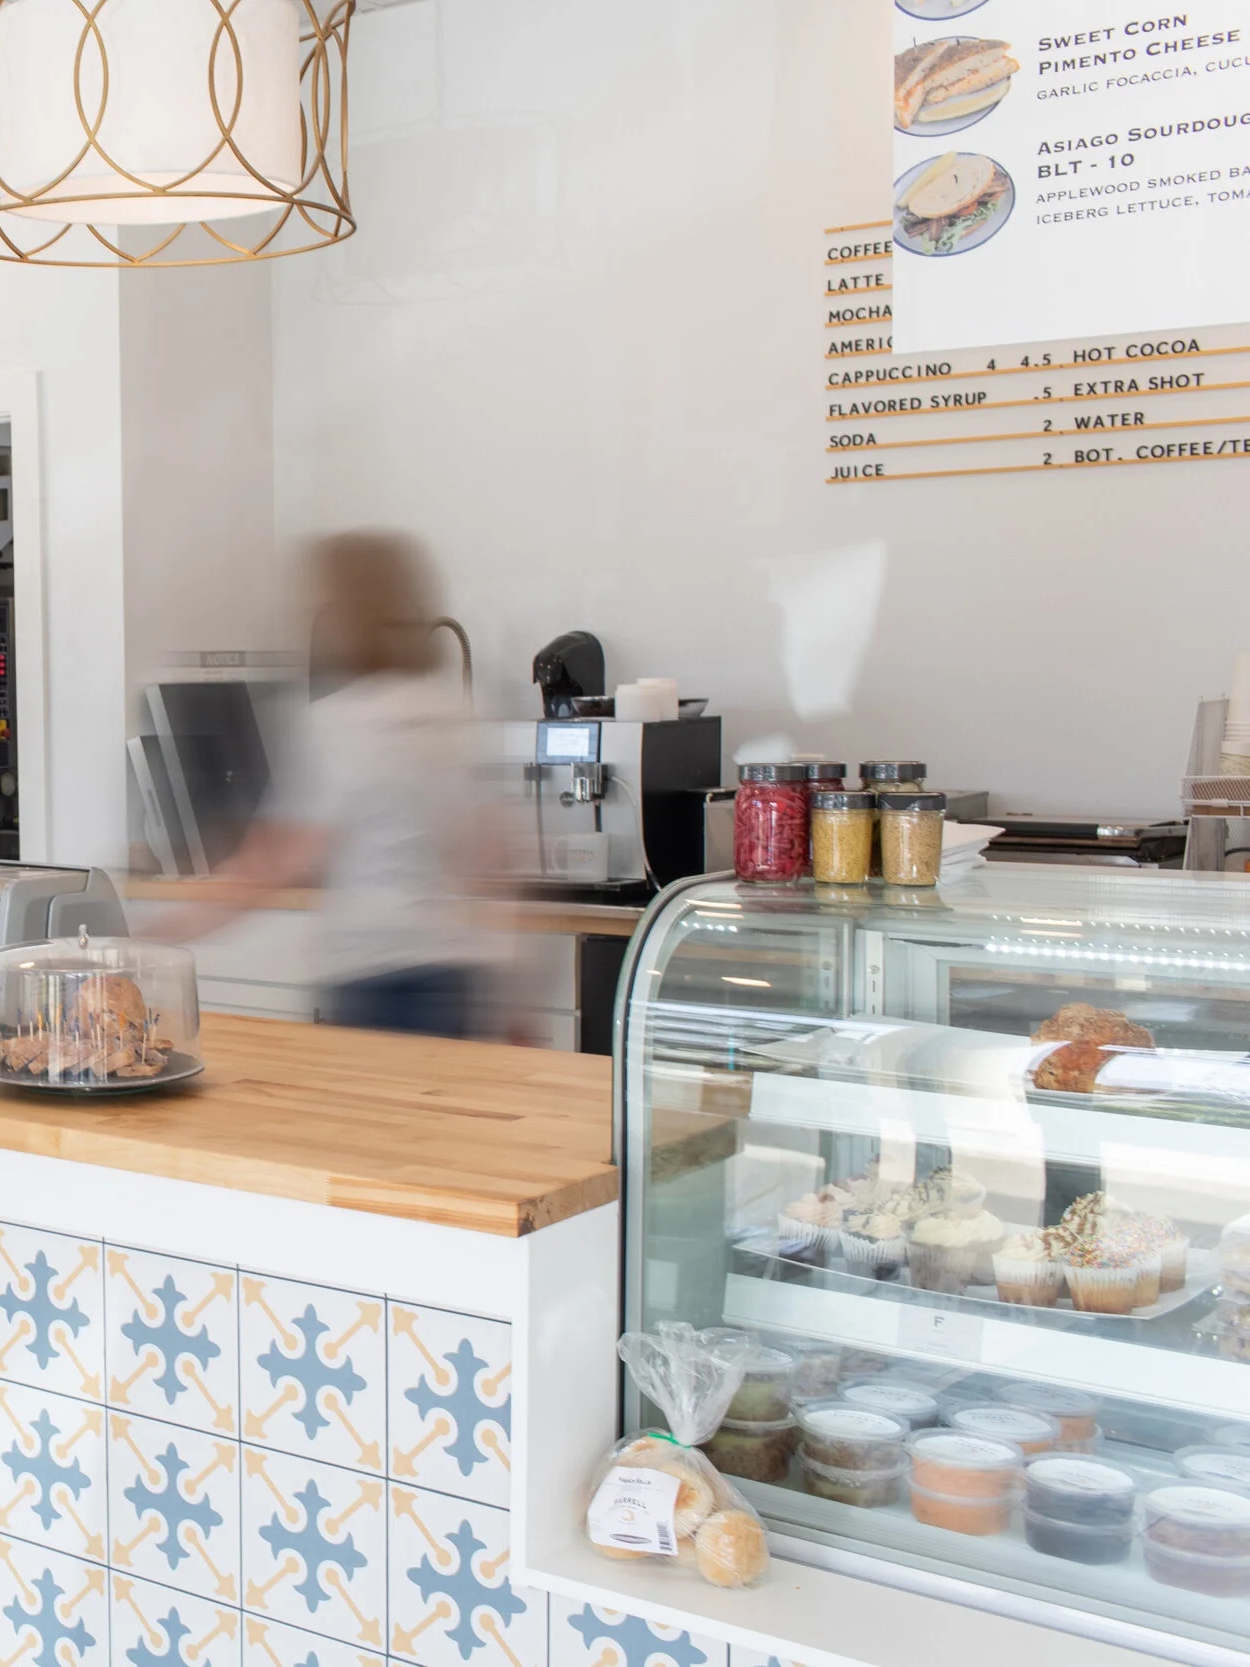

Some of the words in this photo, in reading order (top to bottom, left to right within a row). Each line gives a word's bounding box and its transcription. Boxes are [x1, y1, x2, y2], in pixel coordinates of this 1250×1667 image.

[1038, 28, 1118, 53] SWEET
[1124, 14, 1188, 36] CORN
[1038, 45, 1136, 75] PIMENTO
[1143, 27, 1241, 55] CHEESE
[1037, 82, 1099, 100] GARLIC
[1106, 66, 1198, 89] FOCACCIA,
[1037, 133, 1119, 158] ASIAGO
[1128, 112, 1250, 142] SOURDOUG
[1037, 160, 1082, 180] BLT
[1108, 153, 1135, 170] 10
[1036, 180, 1143, 206] APPLEWOOD
[1147, 170, 1221, 189] SMOKED
[1036, 206, 1109, 224] ICEBERG
[1116, 194, 1200, 214] LETTUCE,
[828, 240, 892, 260] COFFEE
[828, 273, 884, 292] LATTE
[828, 305, 892, 323] MOCHA
[1074, 347, 1116, 363] HOT
[1125, 339, 1200, 358] COCOA
[828, 362, 952, 386] CAPPUCCINO
[986, 359, 996, 372] 4
[1020, 353, 1052, 368] 4.5
[1074, 379, 1140, 396] EXTRA
[1148, 373, 1205, 390] SHOT
[829, 397, 922, 417] FLAVORED
[930, 391, 987, 409] SYRUP
[1034, 387, 1052, 400] .5
[829, 432, 877, 448] SODA
[1043, 420, 1052, 432] 2
[1074, 412, 1145, 429] WATER
[1074, 448, 1123, 463] BOT.
[1136, 439, 1250, 460] COFFEE/TE
[831, 464, 884, 480] JUICE
[1043, 453, 1052, 465] 2
